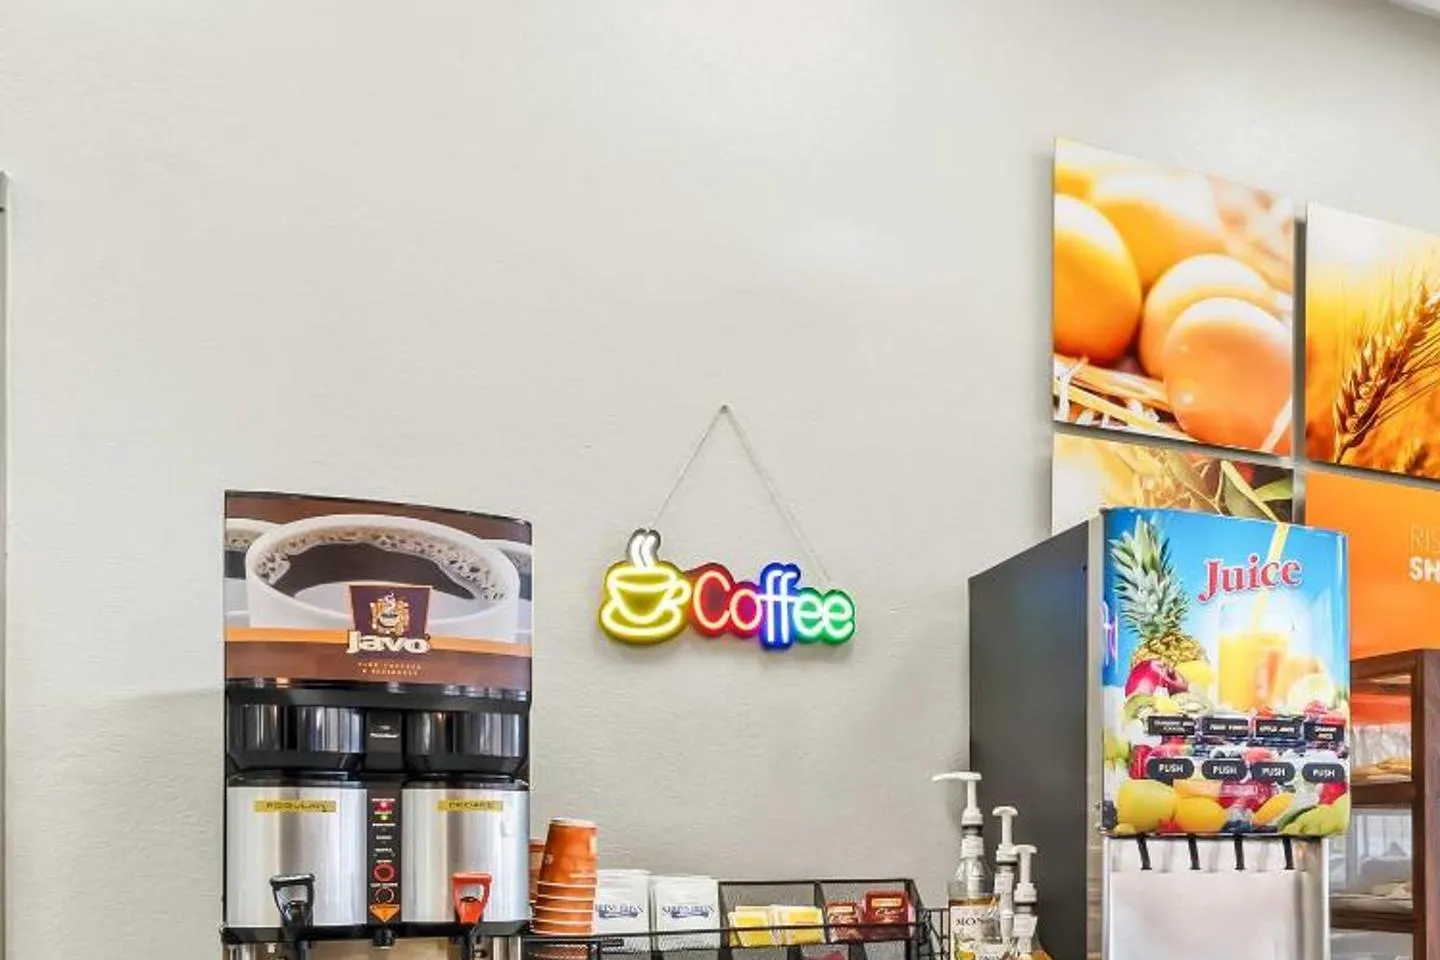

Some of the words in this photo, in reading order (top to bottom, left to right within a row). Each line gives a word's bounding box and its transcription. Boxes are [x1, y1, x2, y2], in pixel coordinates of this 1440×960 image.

[1197, 553, 1304, 603] Juice
[692, 567, 855, 645] Coffee
[1158, 763, 1184, 773] PUSH
[1212, 764, 1238, 774] PUSH
[1261, 766, 1286, 777] PUSH
[1312, 768, 1336, 778] PUSH
